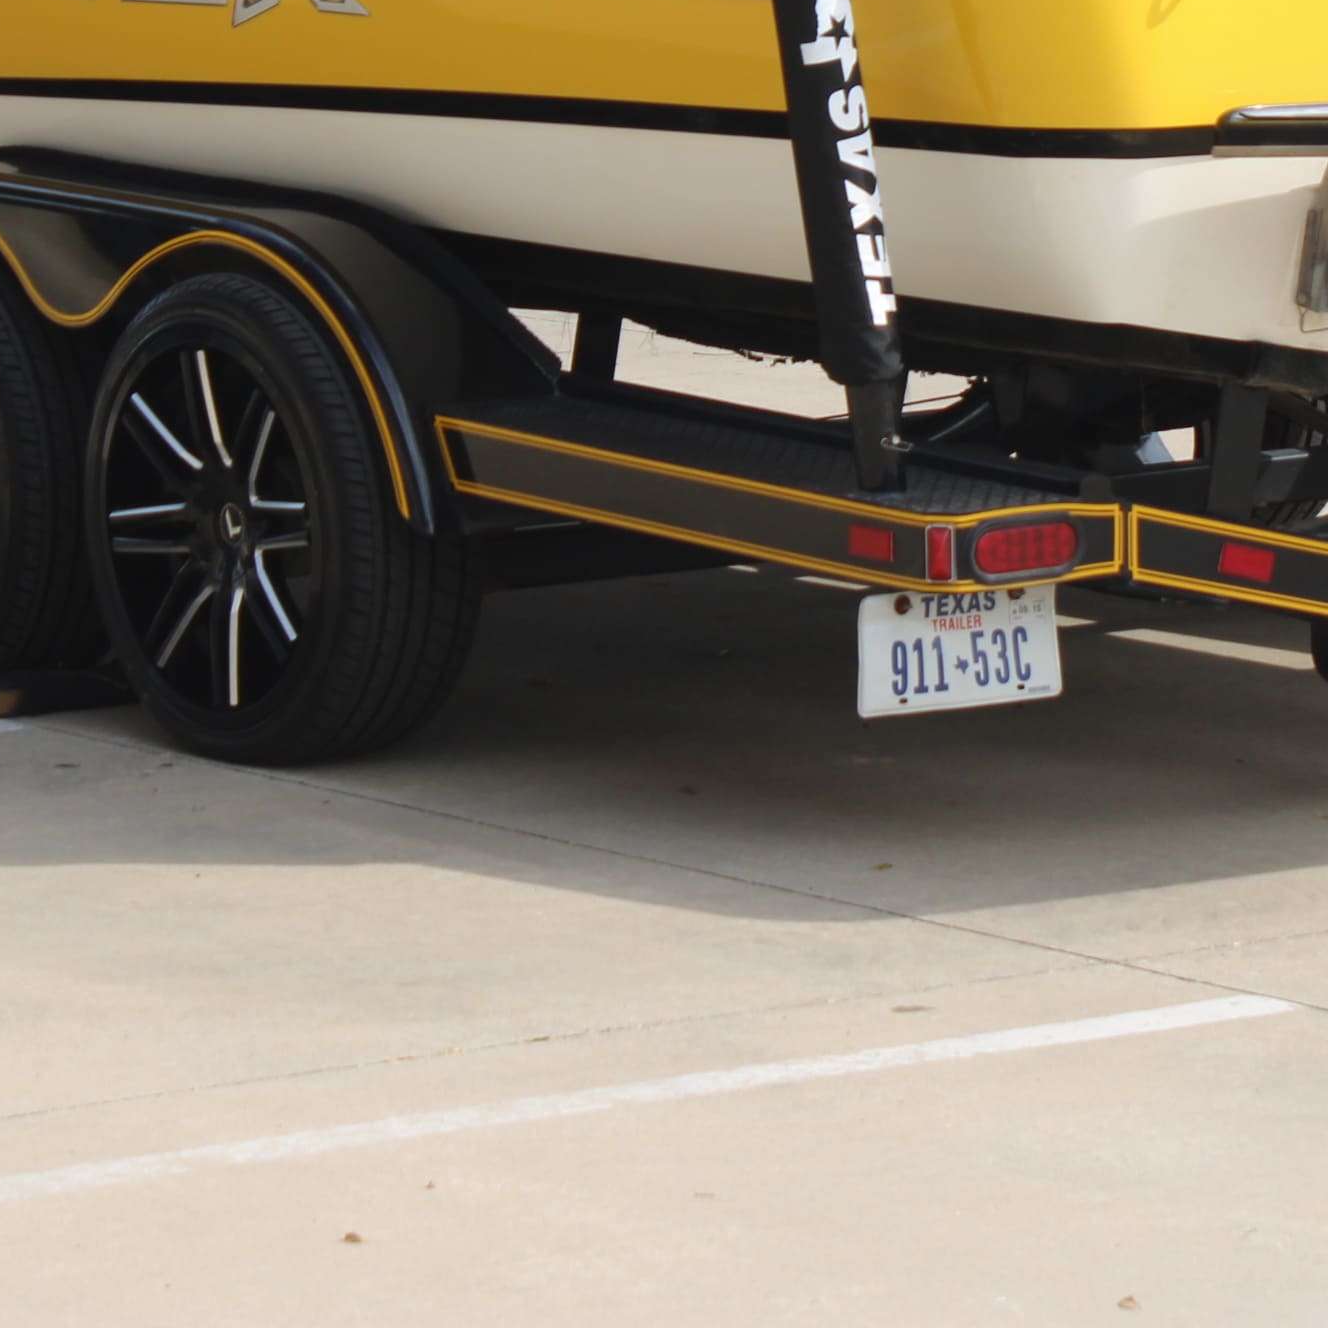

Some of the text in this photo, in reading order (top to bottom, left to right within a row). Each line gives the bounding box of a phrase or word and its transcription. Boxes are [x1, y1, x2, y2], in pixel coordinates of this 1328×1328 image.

[828, 85, 898, 326] TEXAS
[922, 590, 996, 618] TEXAS
[933, 614, 982, 632] TRAILER
[891, 626, 1032, 696] 911 53C
